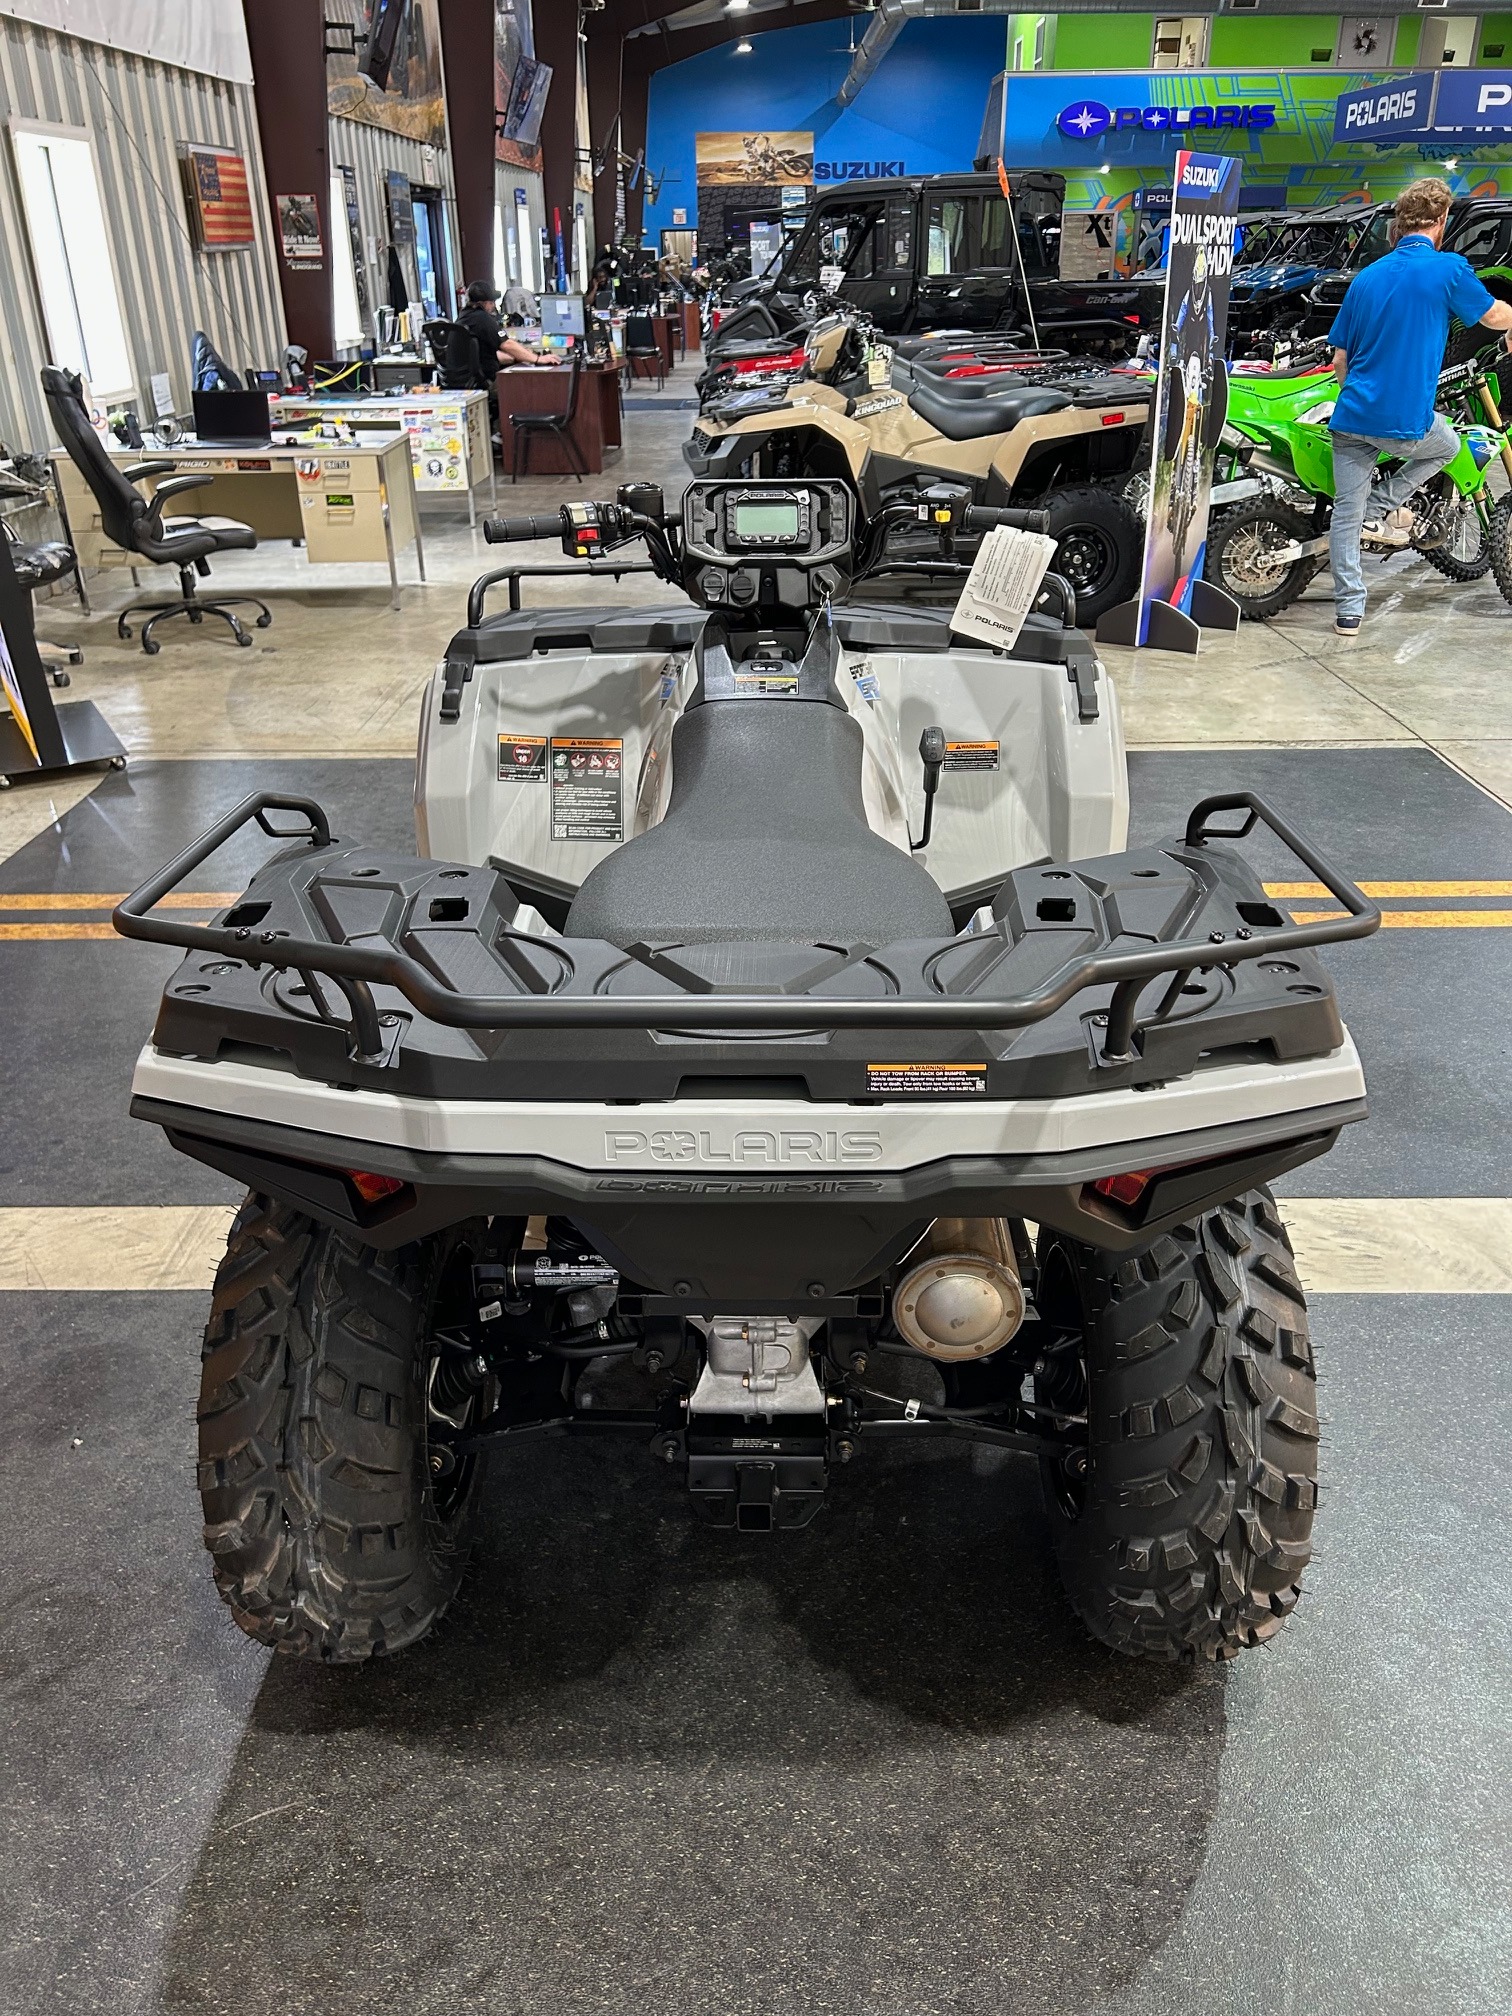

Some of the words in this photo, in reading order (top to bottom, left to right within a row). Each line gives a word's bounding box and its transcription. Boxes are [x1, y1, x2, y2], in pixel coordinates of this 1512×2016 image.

[1115, 104, 1276, 131] POLARIS
[1345, 89, 1417, 129] POLARIS
[814, 161, 905, 179] SUZUKI
[1182, 165, 1219, 187] SUZUKI
[1147, 194, 1172, 203] POL
[1228, 382, 1256, 391] awasaki
[1437, 369, 1468, 386] ENTHAL
[854, 397, 903, 417] KINGQUAD
[974, 614, 1016, 634] POLARIS
[604, 1131, 883, 1162] POLARIS
